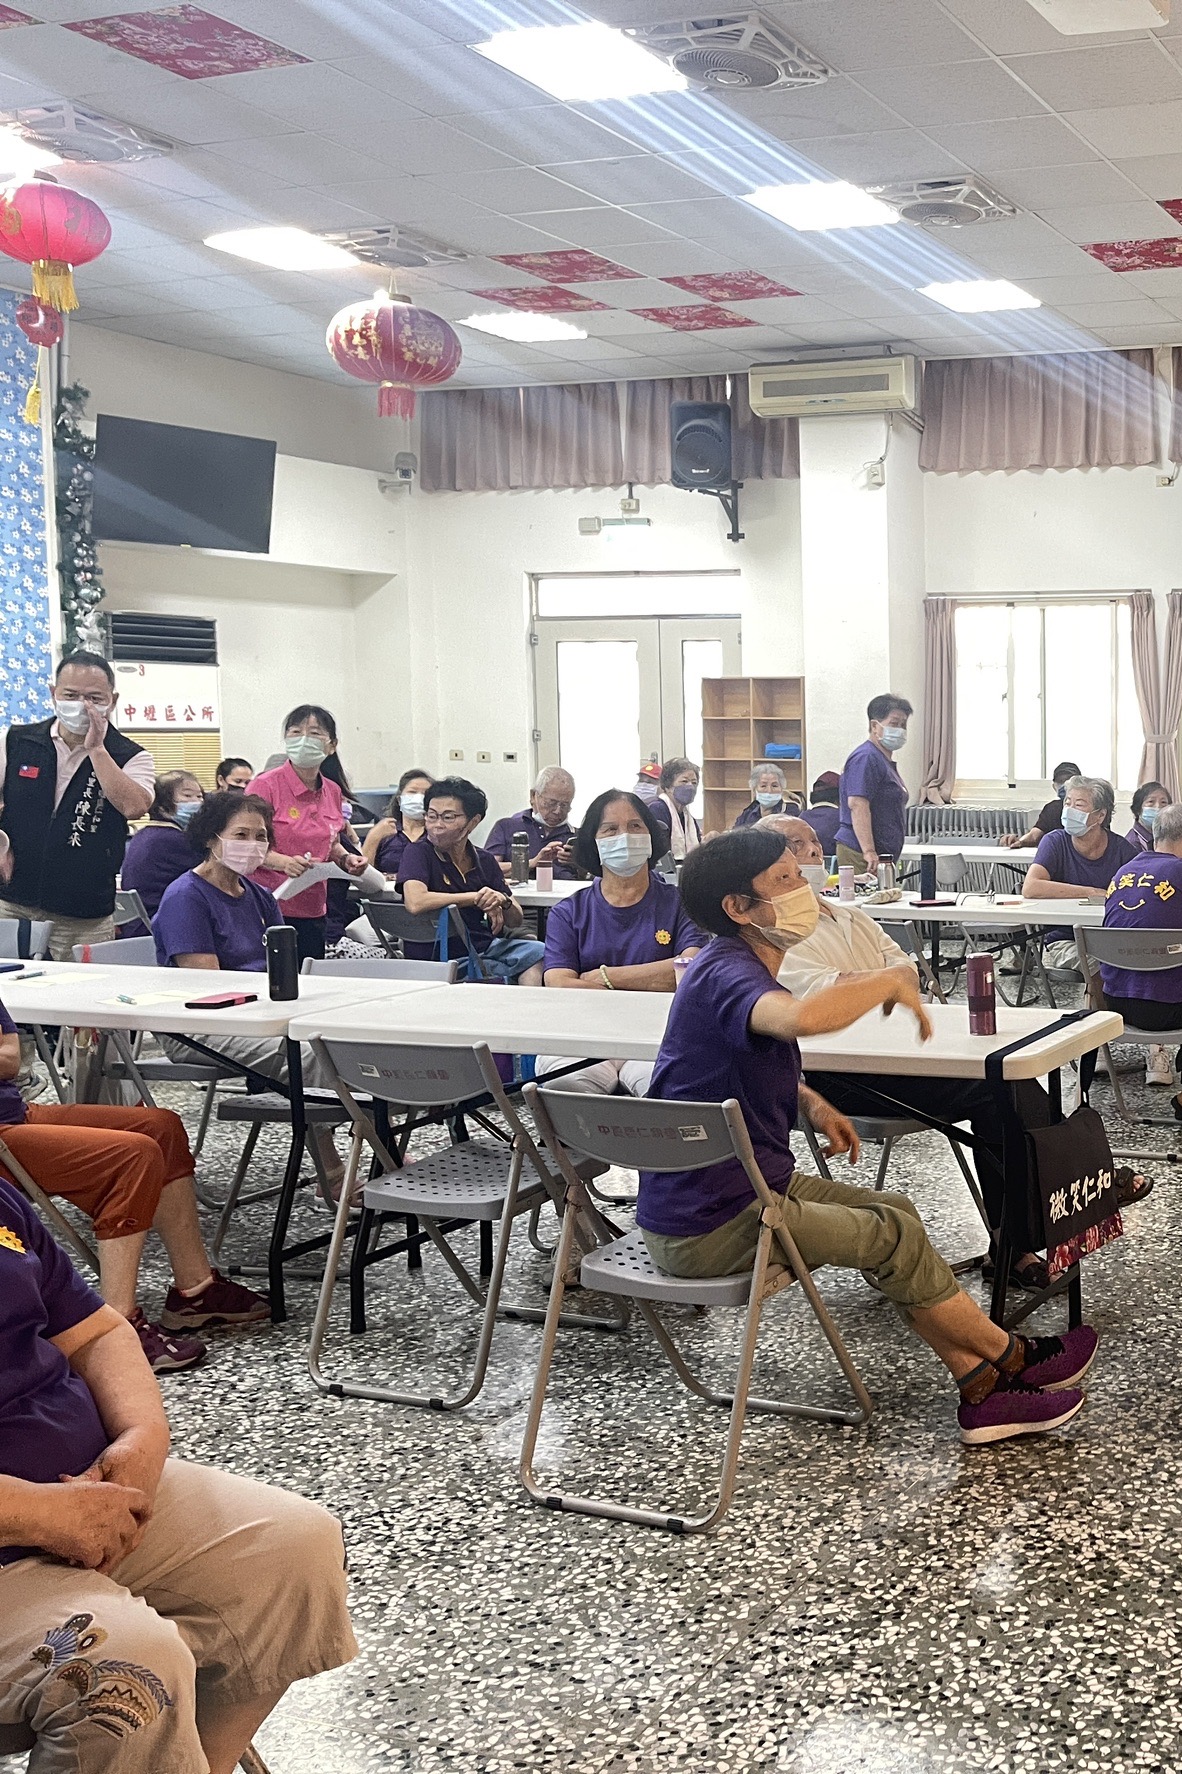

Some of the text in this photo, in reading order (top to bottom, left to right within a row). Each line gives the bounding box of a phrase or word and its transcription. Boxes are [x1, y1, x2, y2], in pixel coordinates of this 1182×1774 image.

[139, 664, 145, 676] 3
[124, 704, 214, 722] 中壢區公所
[1049, 1168, 1111, 1224] 微笑仁和
